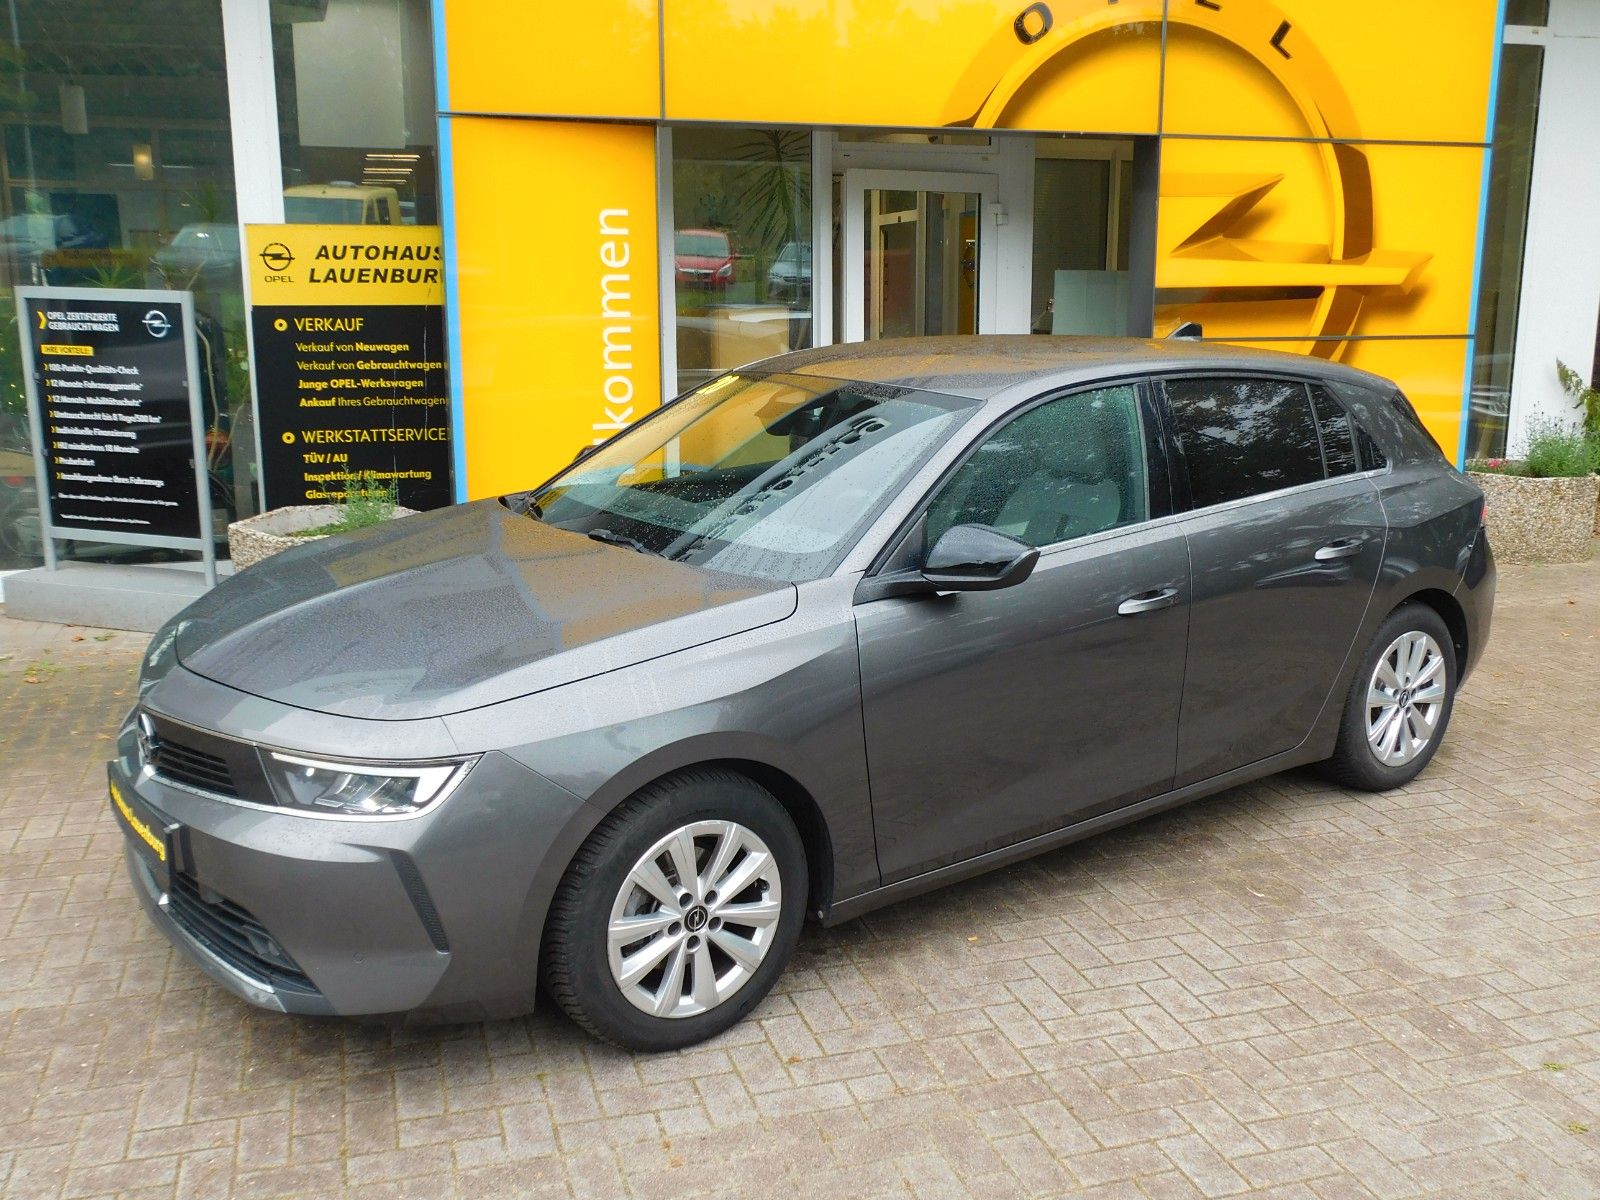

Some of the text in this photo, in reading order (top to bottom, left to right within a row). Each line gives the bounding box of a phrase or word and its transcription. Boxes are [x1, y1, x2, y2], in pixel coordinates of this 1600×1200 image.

[315, 244, 441, 262] AUTOHAUS
[264, 275, 294, 283] OPEL
[308, 267, 443, 284] LAUENBUR
[46, 311, 67, 320] OPEL
[48, 321, 120, 333] GEBRAUCHTWAGEN
[294, 318, 364, 332] VERKAUF
[296, 343, 409, 354] Verkauf von Neuwagen
[296, 360, 335, 371] Verkauf
[337, 362, 355, 370] von
[356, 360, 442, 371] Gebrauchtwagen
[298, 378, 424, 391] Junge OPEL-Werkswagen
[300, 396, 447, 407] Ankauf Ihres Gebrauchtwagen
[303, 453, 325, 463] TÜV
[333, 454, 348, 463] AU
[304, 472, 355, 482] Inspektion
[364, 470, 431, 480] Klimawartung
